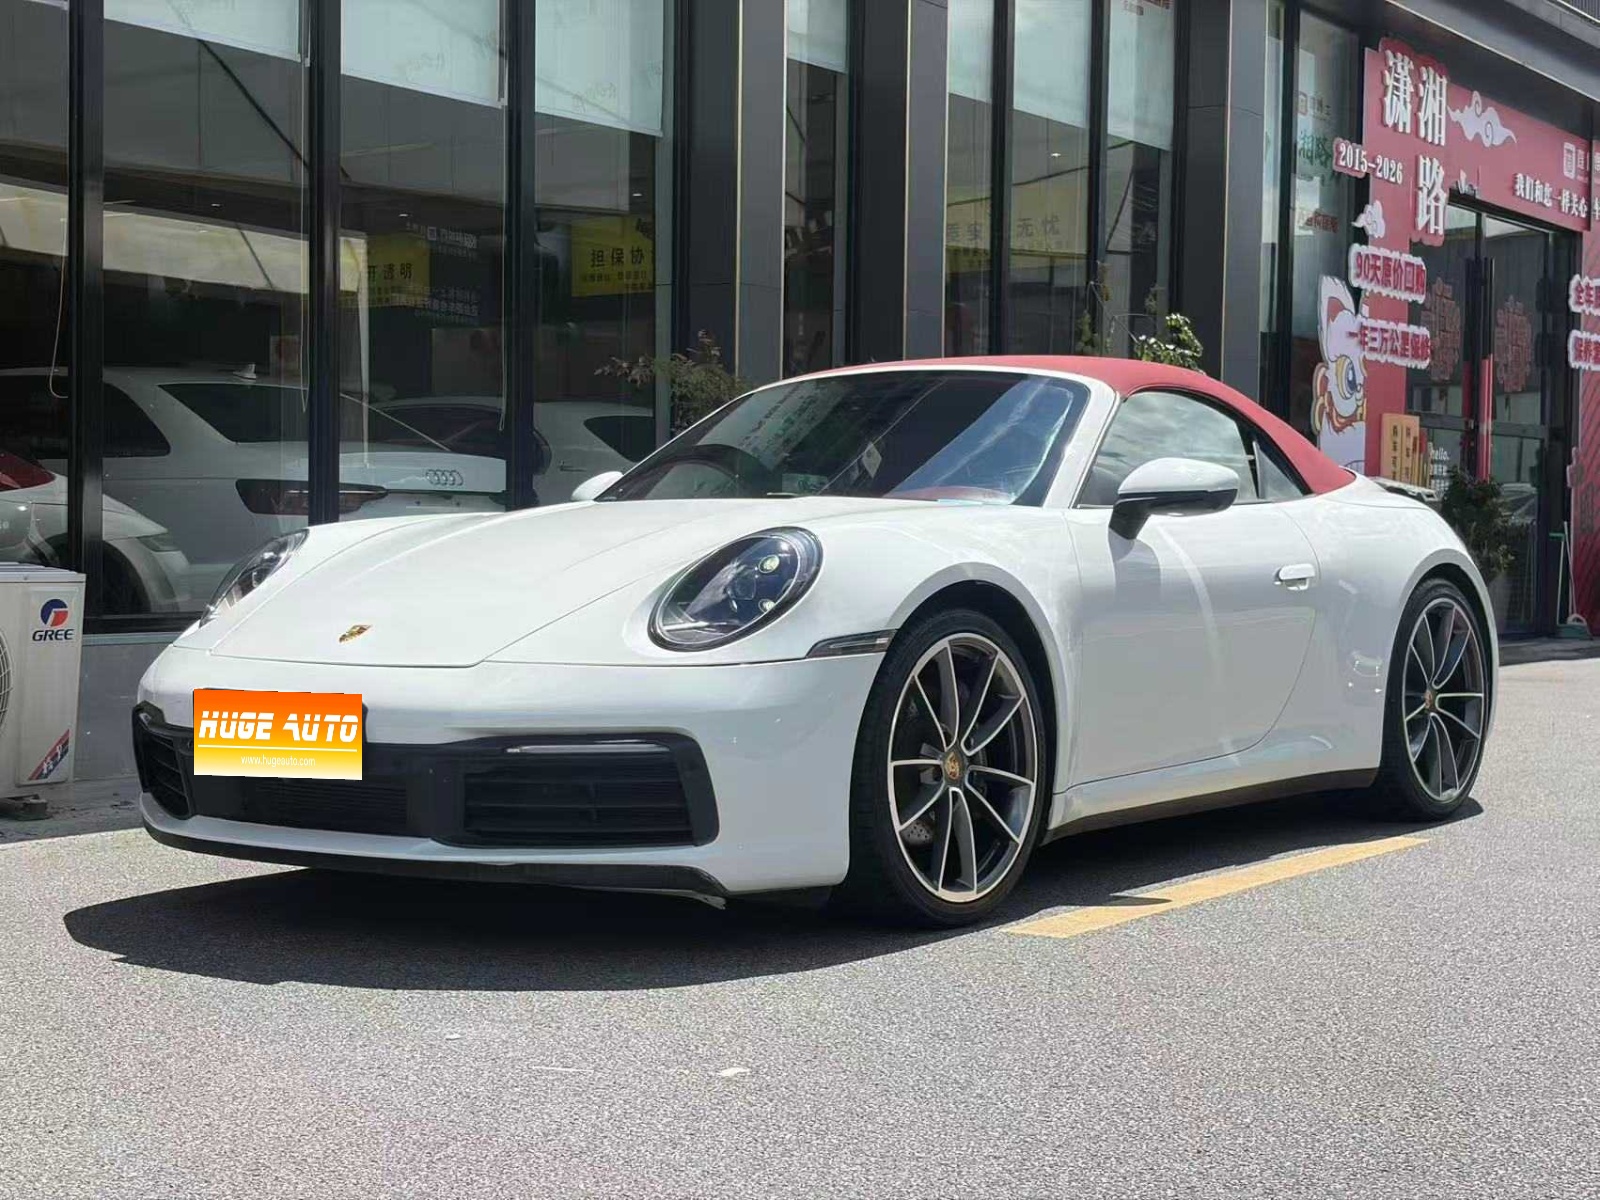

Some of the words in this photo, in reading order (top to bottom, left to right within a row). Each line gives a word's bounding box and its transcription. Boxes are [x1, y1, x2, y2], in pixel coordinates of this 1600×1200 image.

[1383, 50, 1447, 146] 潇湘
[1418, 155, 1446, 235] 路
[32, 628, 74, 641] GREE
